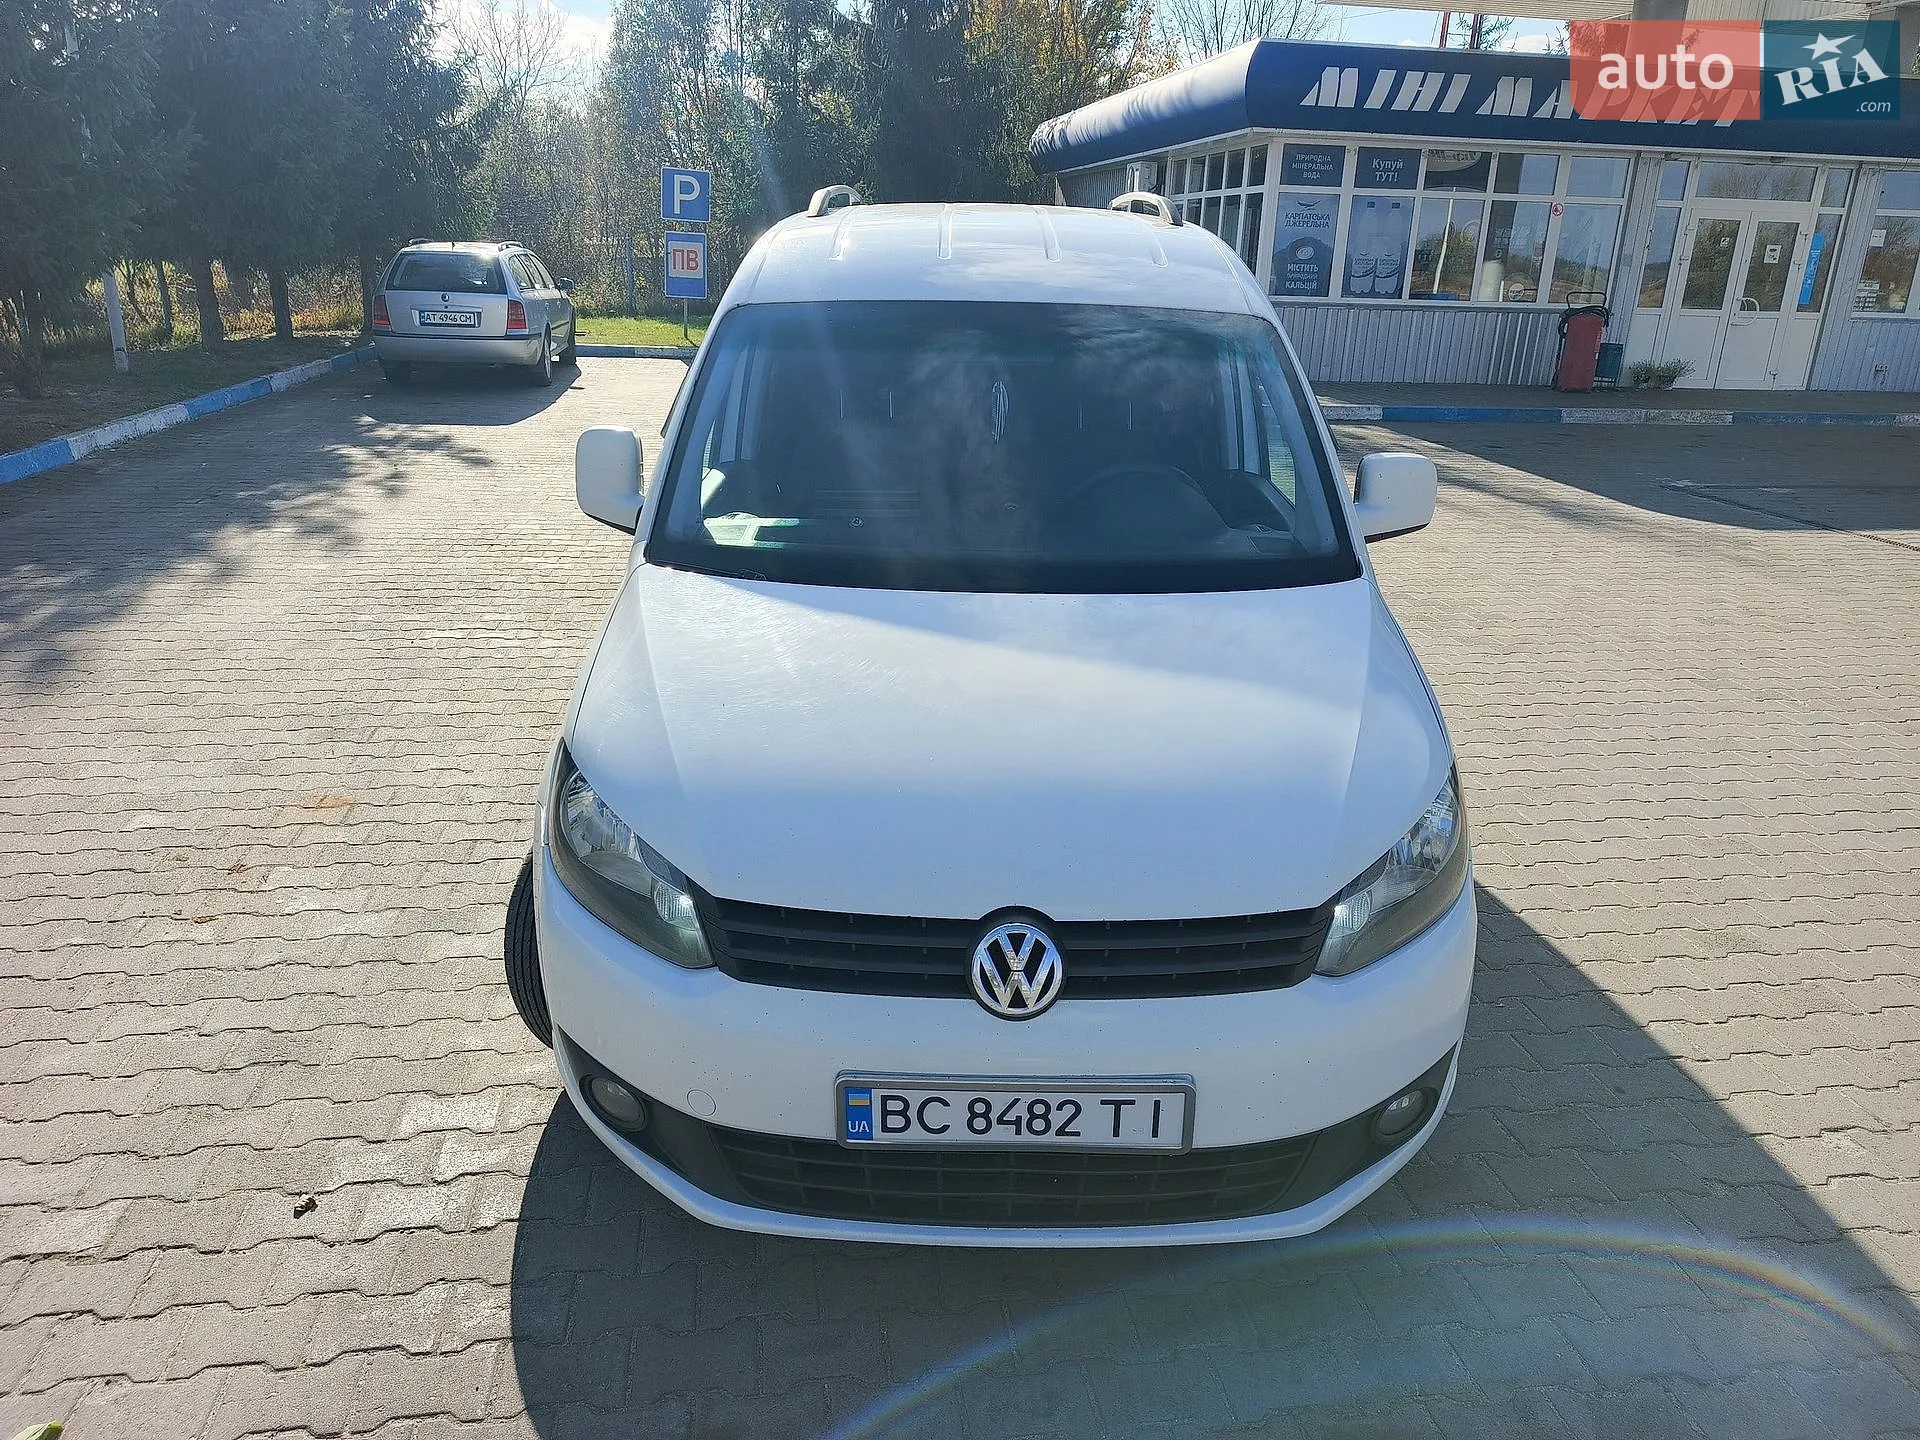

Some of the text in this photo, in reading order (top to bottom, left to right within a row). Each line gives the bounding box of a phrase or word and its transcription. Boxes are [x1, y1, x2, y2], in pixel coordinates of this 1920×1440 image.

[1299, 66, 1472, 113] МІНІ
[1296, 152, 1332, 162] ПРИРОДНА
[1292, 162, 1334, 171] МІНЕРАЛЬНА
[1372, 158, 1404, 171] Купуй
[1303, 171, 1321, 179] ВОДА
[1375, 171, 1398, 182] ТУТ!
[674, 174, 701, 215] P
[1285, 211, 1331, 222] КАРПАТСЬКА
[1284, 219, 1330, 229] ДЖЕРЕЛЬНА
[672, 248, 699, 271] ПВ
[1287, 263, 1319, 273] МІСТИТЬ
[1285, 280, 1318, 291] КАЛЬЦІЙ
[425, 313, 437, 322] AT
[880, 1094, 951, 1135] BC
[966, 1097, 1083, 1138] 8482
[847, 1120, 870, 1133] UA
